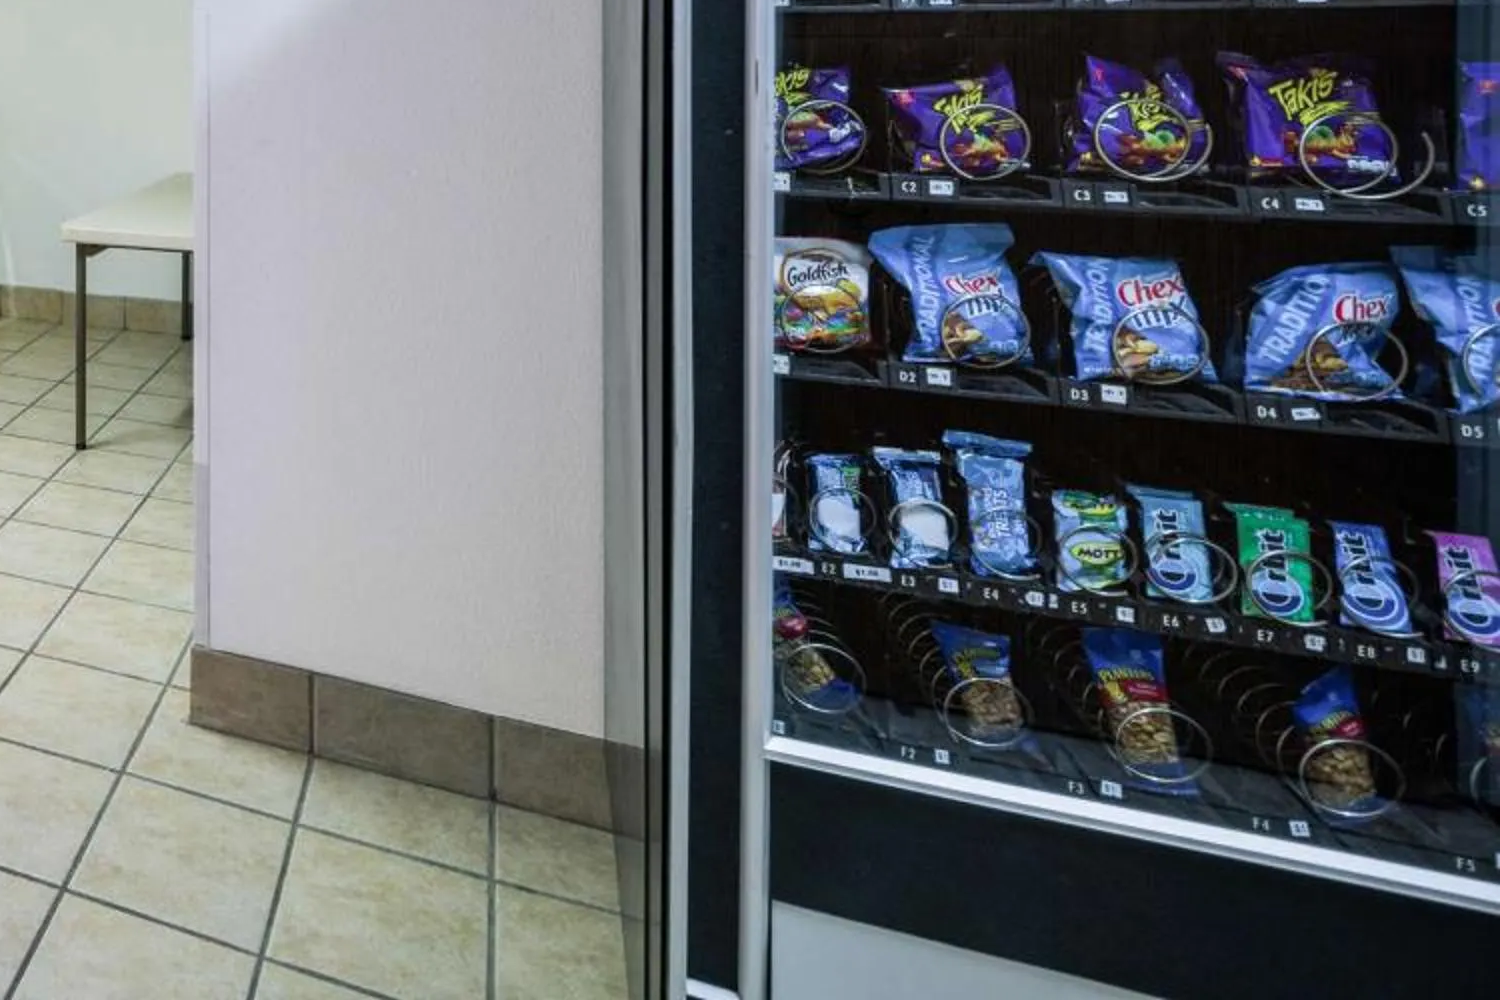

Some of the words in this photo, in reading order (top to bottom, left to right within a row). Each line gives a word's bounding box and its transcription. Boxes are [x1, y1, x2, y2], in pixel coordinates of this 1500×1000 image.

[901, 180, 917, 193] C2
[1074, 189, 1091, 201] C3
[1261, 196, 1280, 210] C4
[1467, 204, 1488, 218] C5
[786, 263, 850, 287] Goldfish
[944, 273, 999, 296] Chex
[1117, 276, 1186, 308] Chex
[1334, 294, 1392, 324] Chex
[899, 371, 917, 383] D2
[1070, 386, 1089, 401] D3
[1256, 404, 1277, 419] D4
[1460, 424, 1484, 439] D5
[900, 574, 917, 587] E3
[983, 588, 999, 600] E4
[1070, 601, 1088, 614] E5
[1162, 615, 1180, 628] E6
[1256, 630, 1275, 642] E7
[1357, 644, 1376, 659] E8
[1460, 659, 1480, 674] E9
[1067, 780, 1085, 795] F3
[1252, 816, 1271, 832] F4
[1456, 857, 1477, 873] F5
